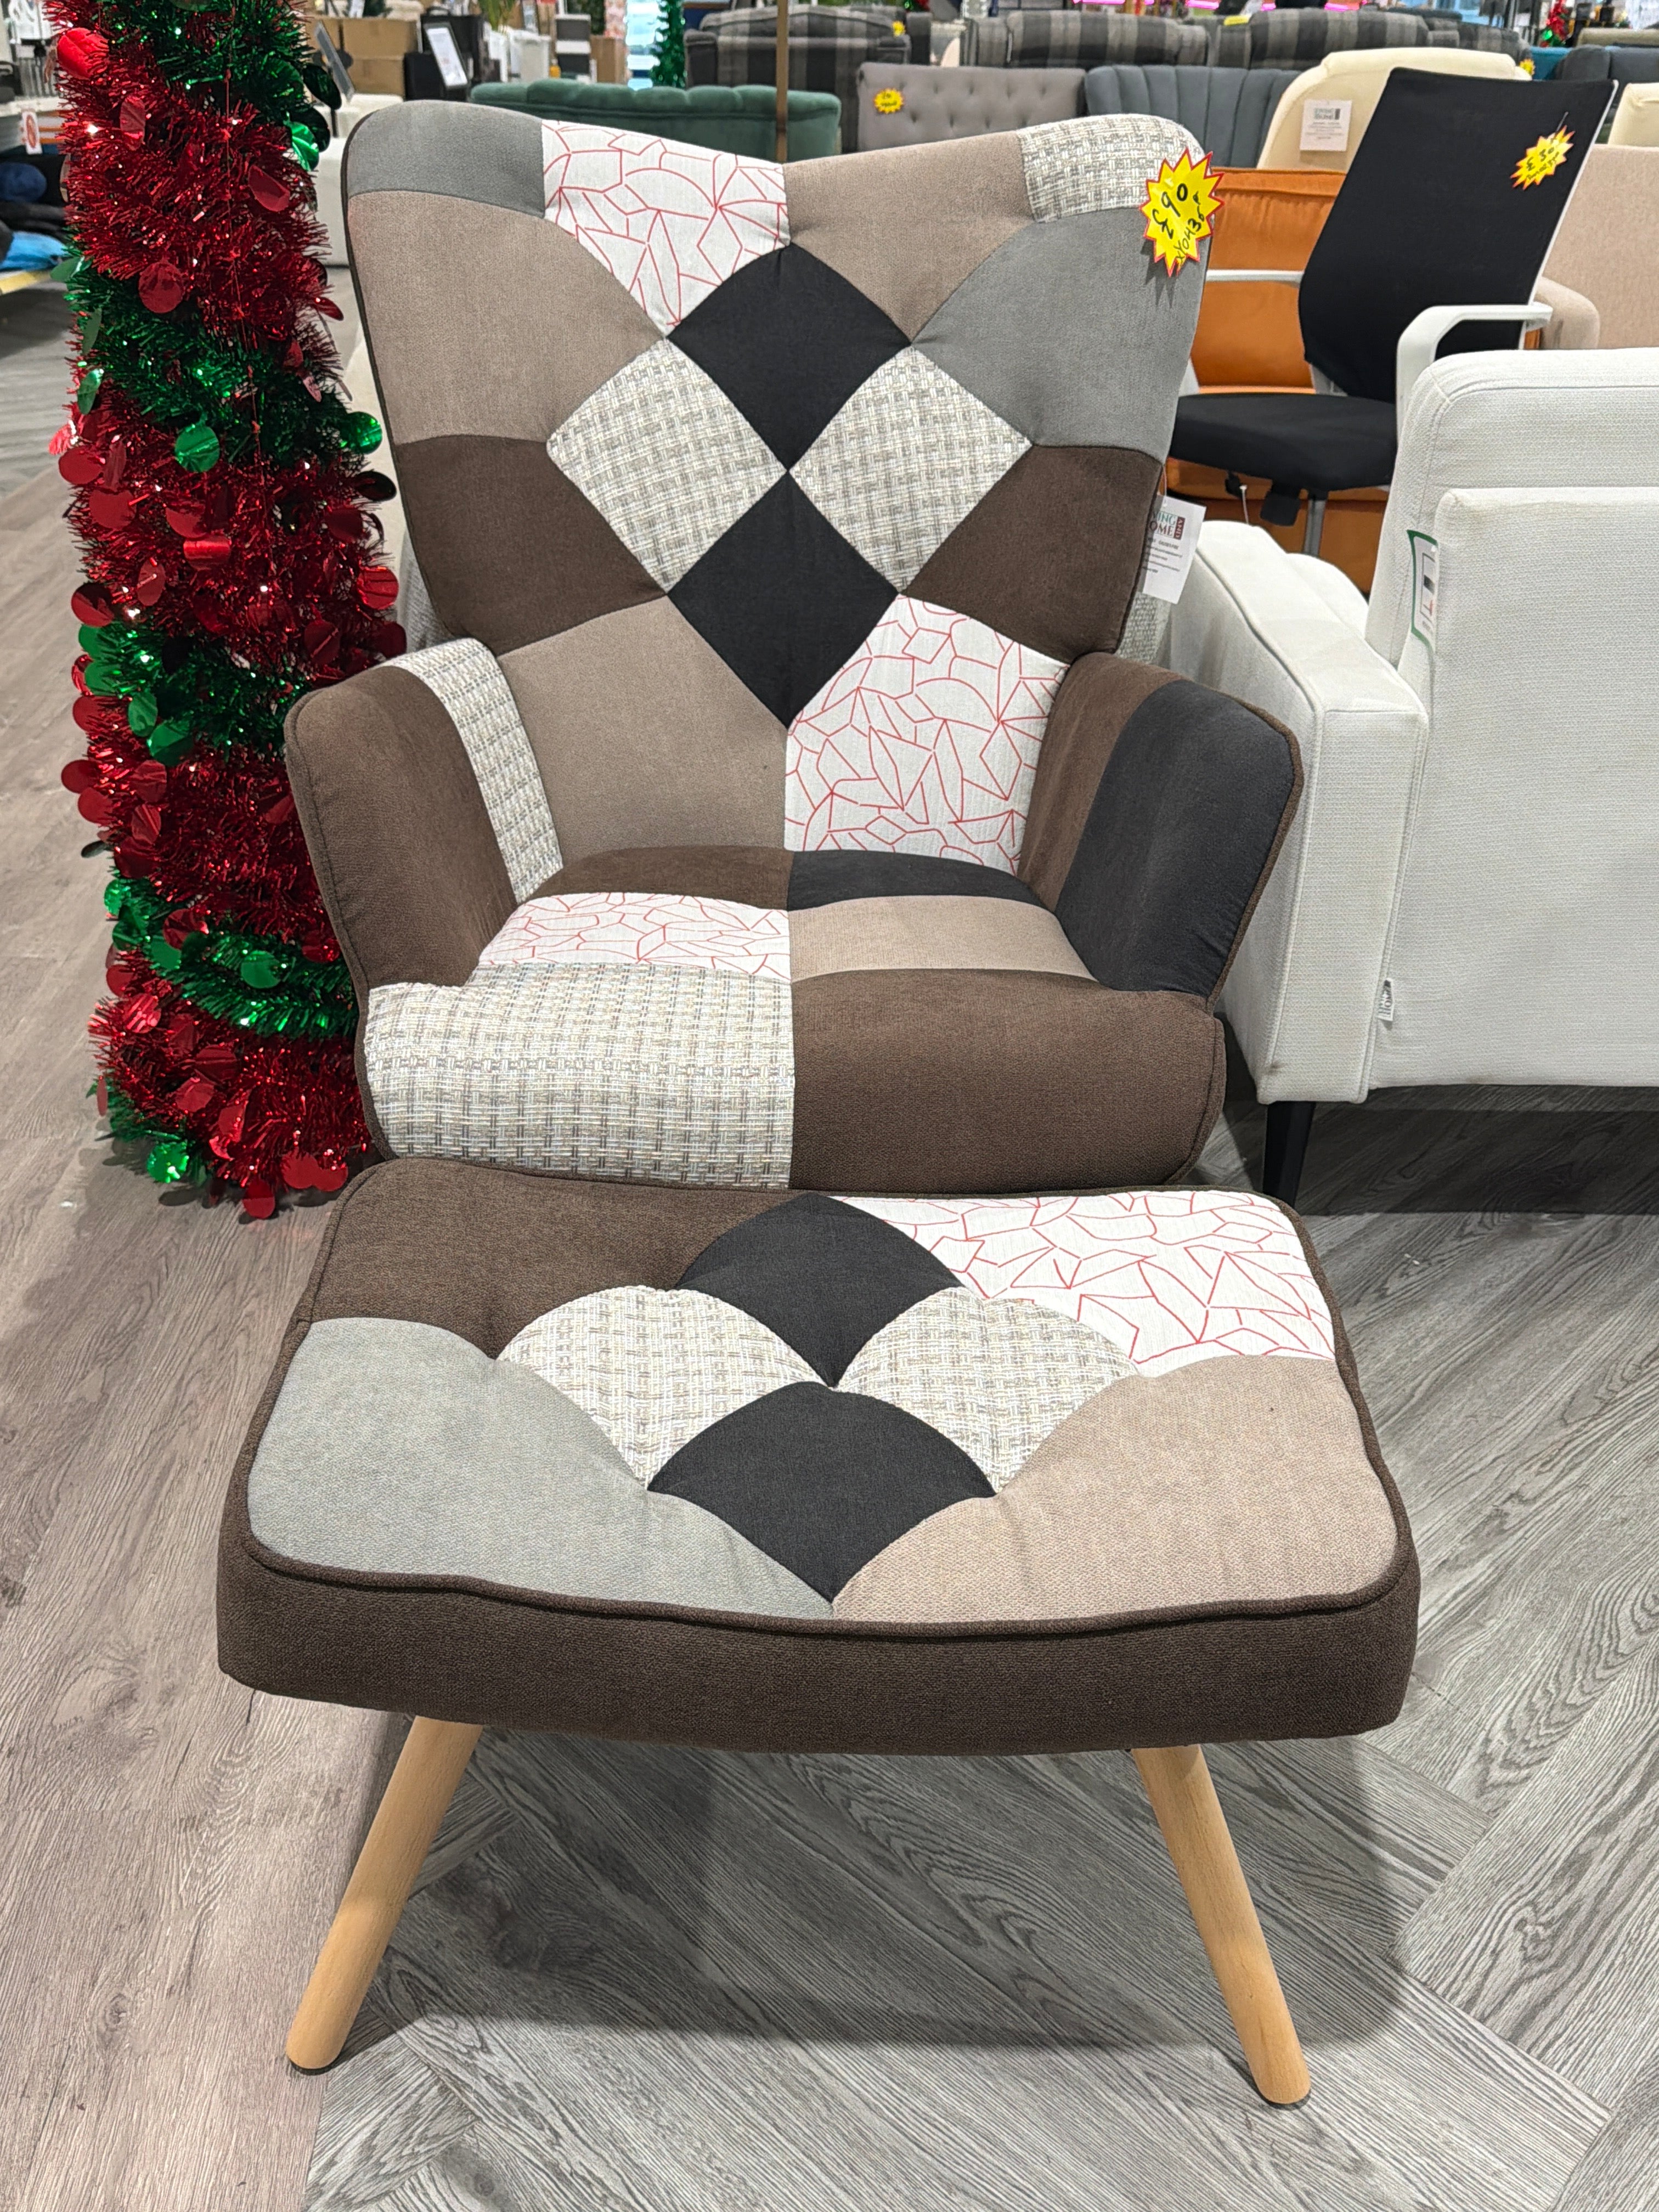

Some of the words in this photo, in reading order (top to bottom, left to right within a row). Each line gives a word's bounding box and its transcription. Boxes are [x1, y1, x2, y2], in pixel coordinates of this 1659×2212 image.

[1152, 183, 1188, 239] £90
[1152, 511, 1176, 525] VING
[1149, 520, 1175, 536] OME
